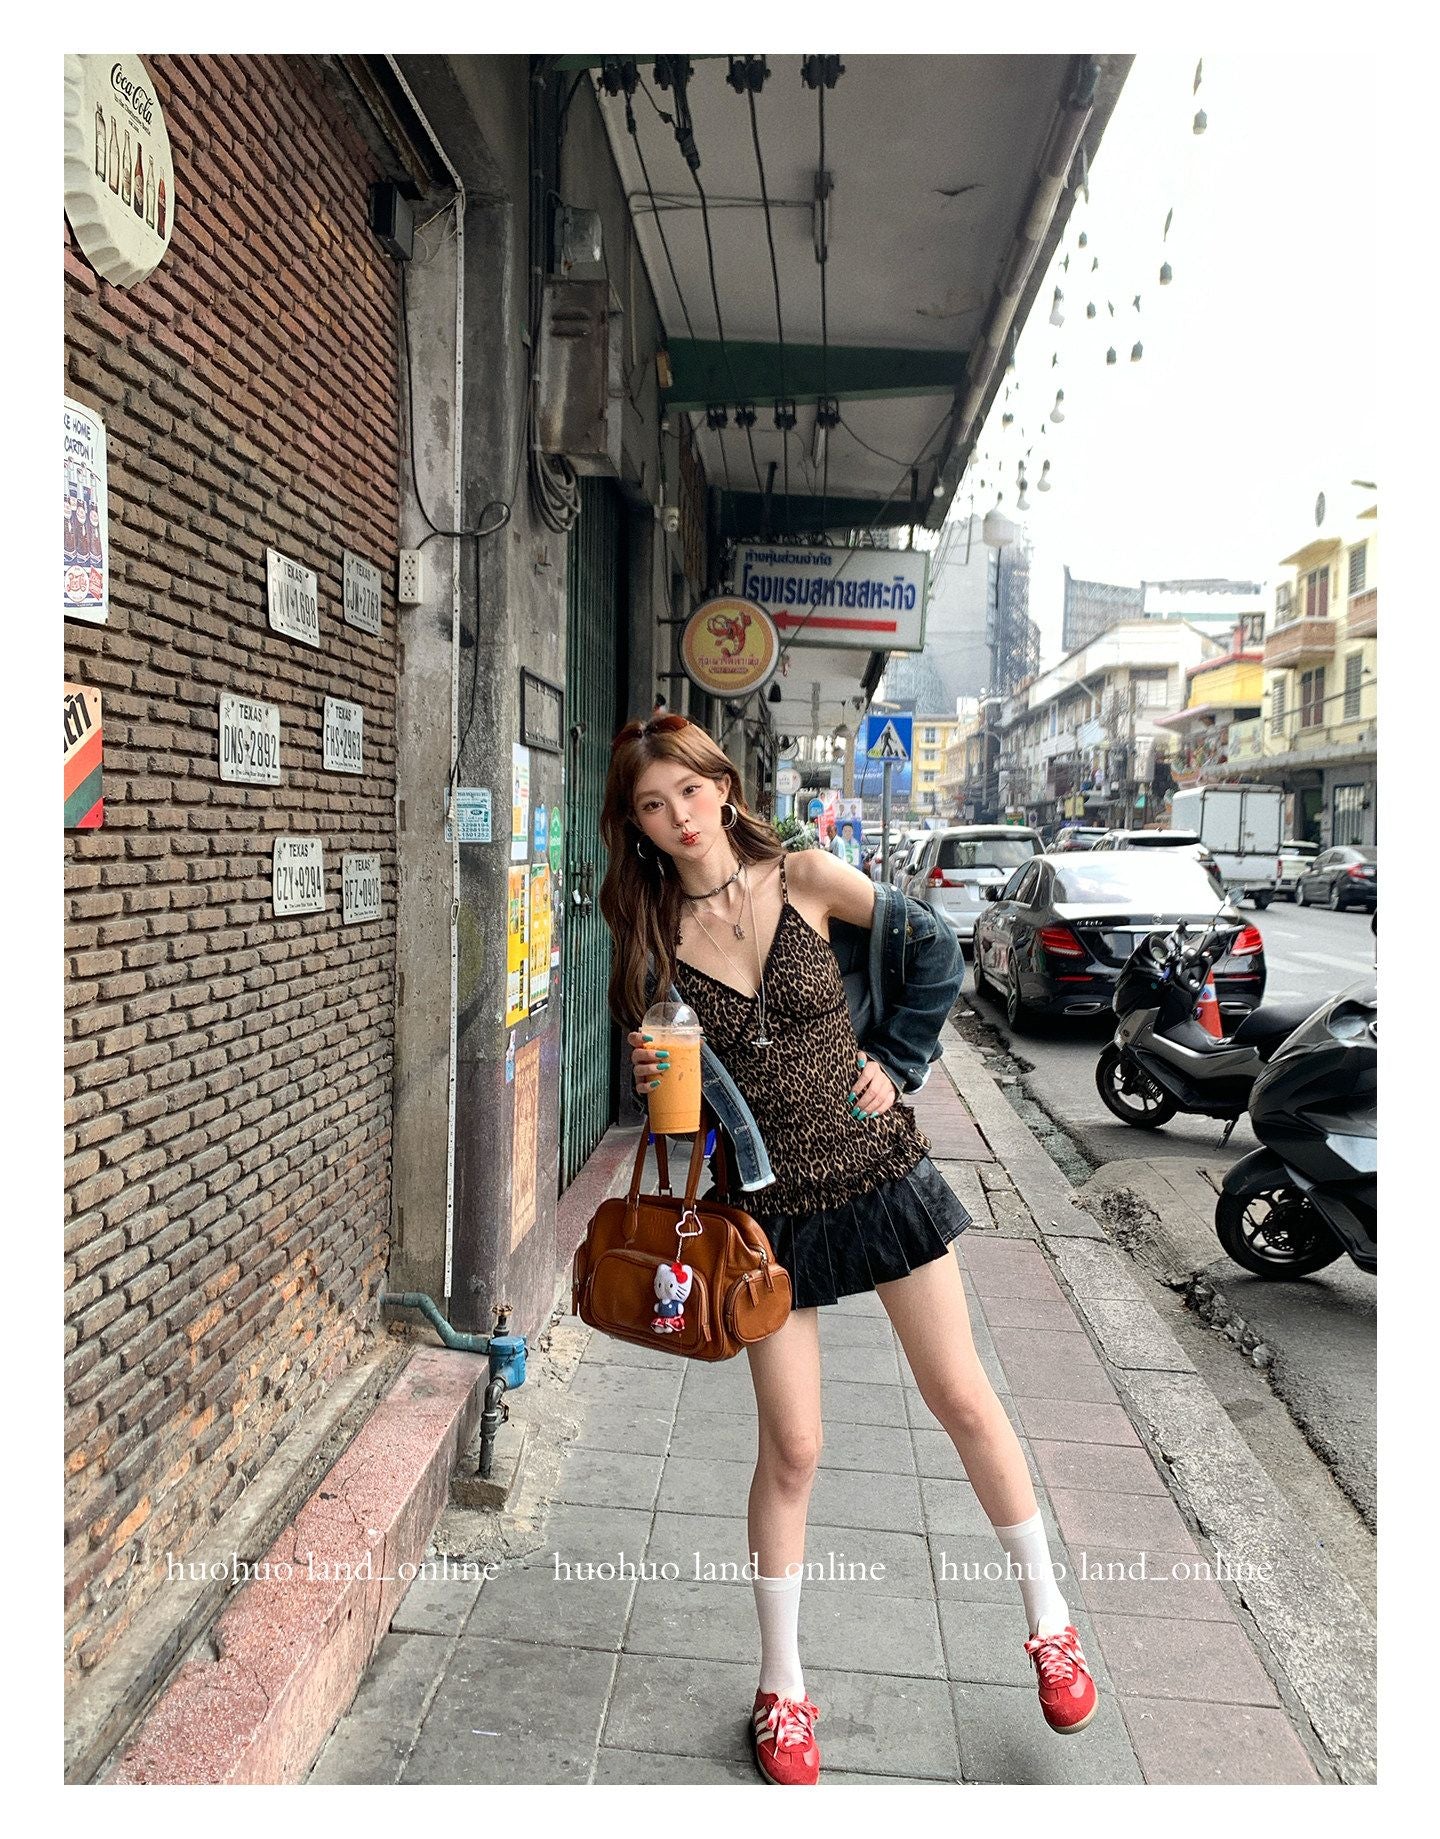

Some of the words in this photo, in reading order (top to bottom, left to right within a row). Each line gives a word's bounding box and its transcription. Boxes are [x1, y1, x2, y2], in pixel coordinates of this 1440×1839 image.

[72, 418, 91, 441] HOME
[283, 562, 303, 583] TEXAS
[356, 562, 371, 581] TEXAS
[239, 704, 262, 722] TEXAS
[335, 706, 352, 721] TEXAS
[289, 844, 309, 857] TEXAS
[355, 859, 371, 871] TEXAS
